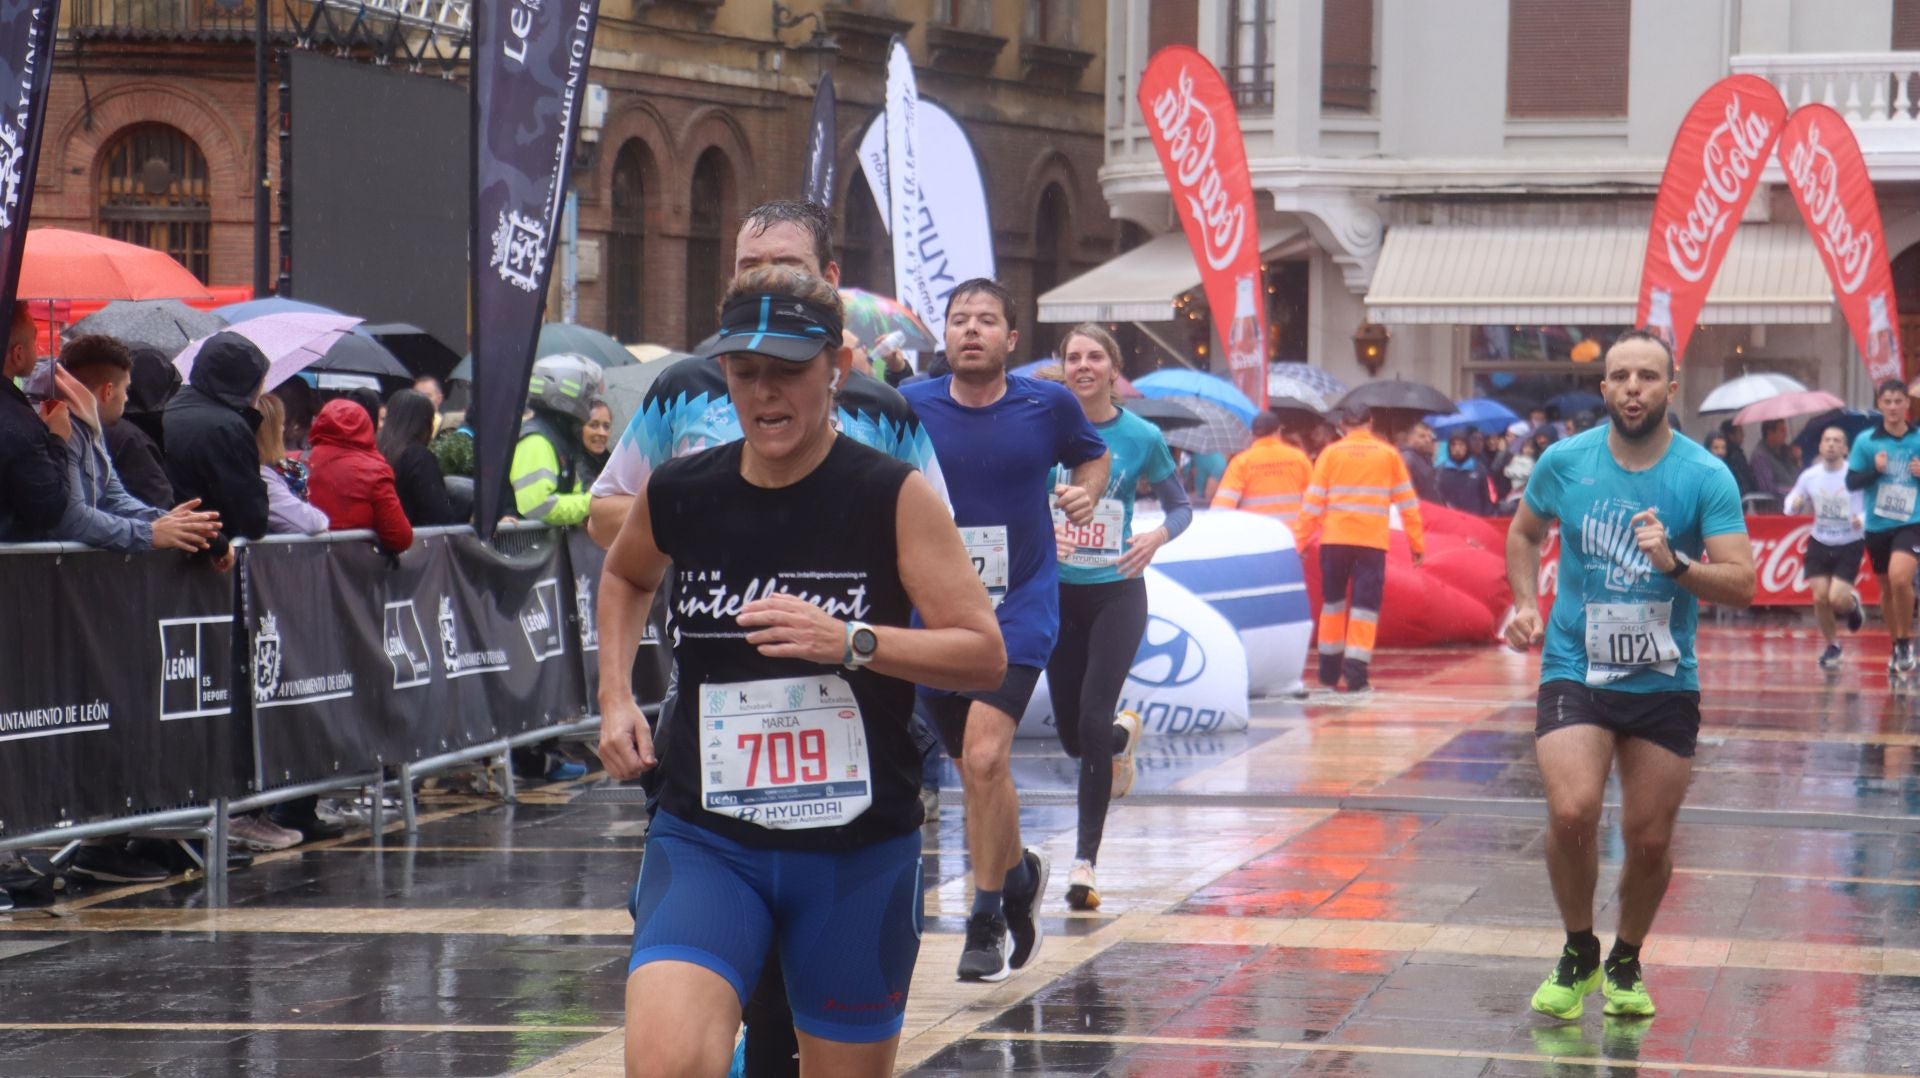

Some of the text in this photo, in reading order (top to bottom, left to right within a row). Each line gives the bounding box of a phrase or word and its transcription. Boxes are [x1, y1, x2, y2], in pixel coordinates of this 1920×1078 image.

[503, 0, 541, 65] Le
[1664, 91, 1769, 283] Coca-Cola
[681, 570, 722, 582] TEAM
[1608, 632, 1660, 664] 1021
[165, 649, 196, 681] LEÓN
[202, 676, 212, 687] ES
[277, 668, 353, 698] AYUNTAMIENTO DE LEÓN
[0, 698, 110, 732] UNTAMIENTO DE LEÓN
[761, 716, 800, 729] MARIA
[737, 728, 828, 788] 709
[766, 801, 843, 820] HYUNDAI
